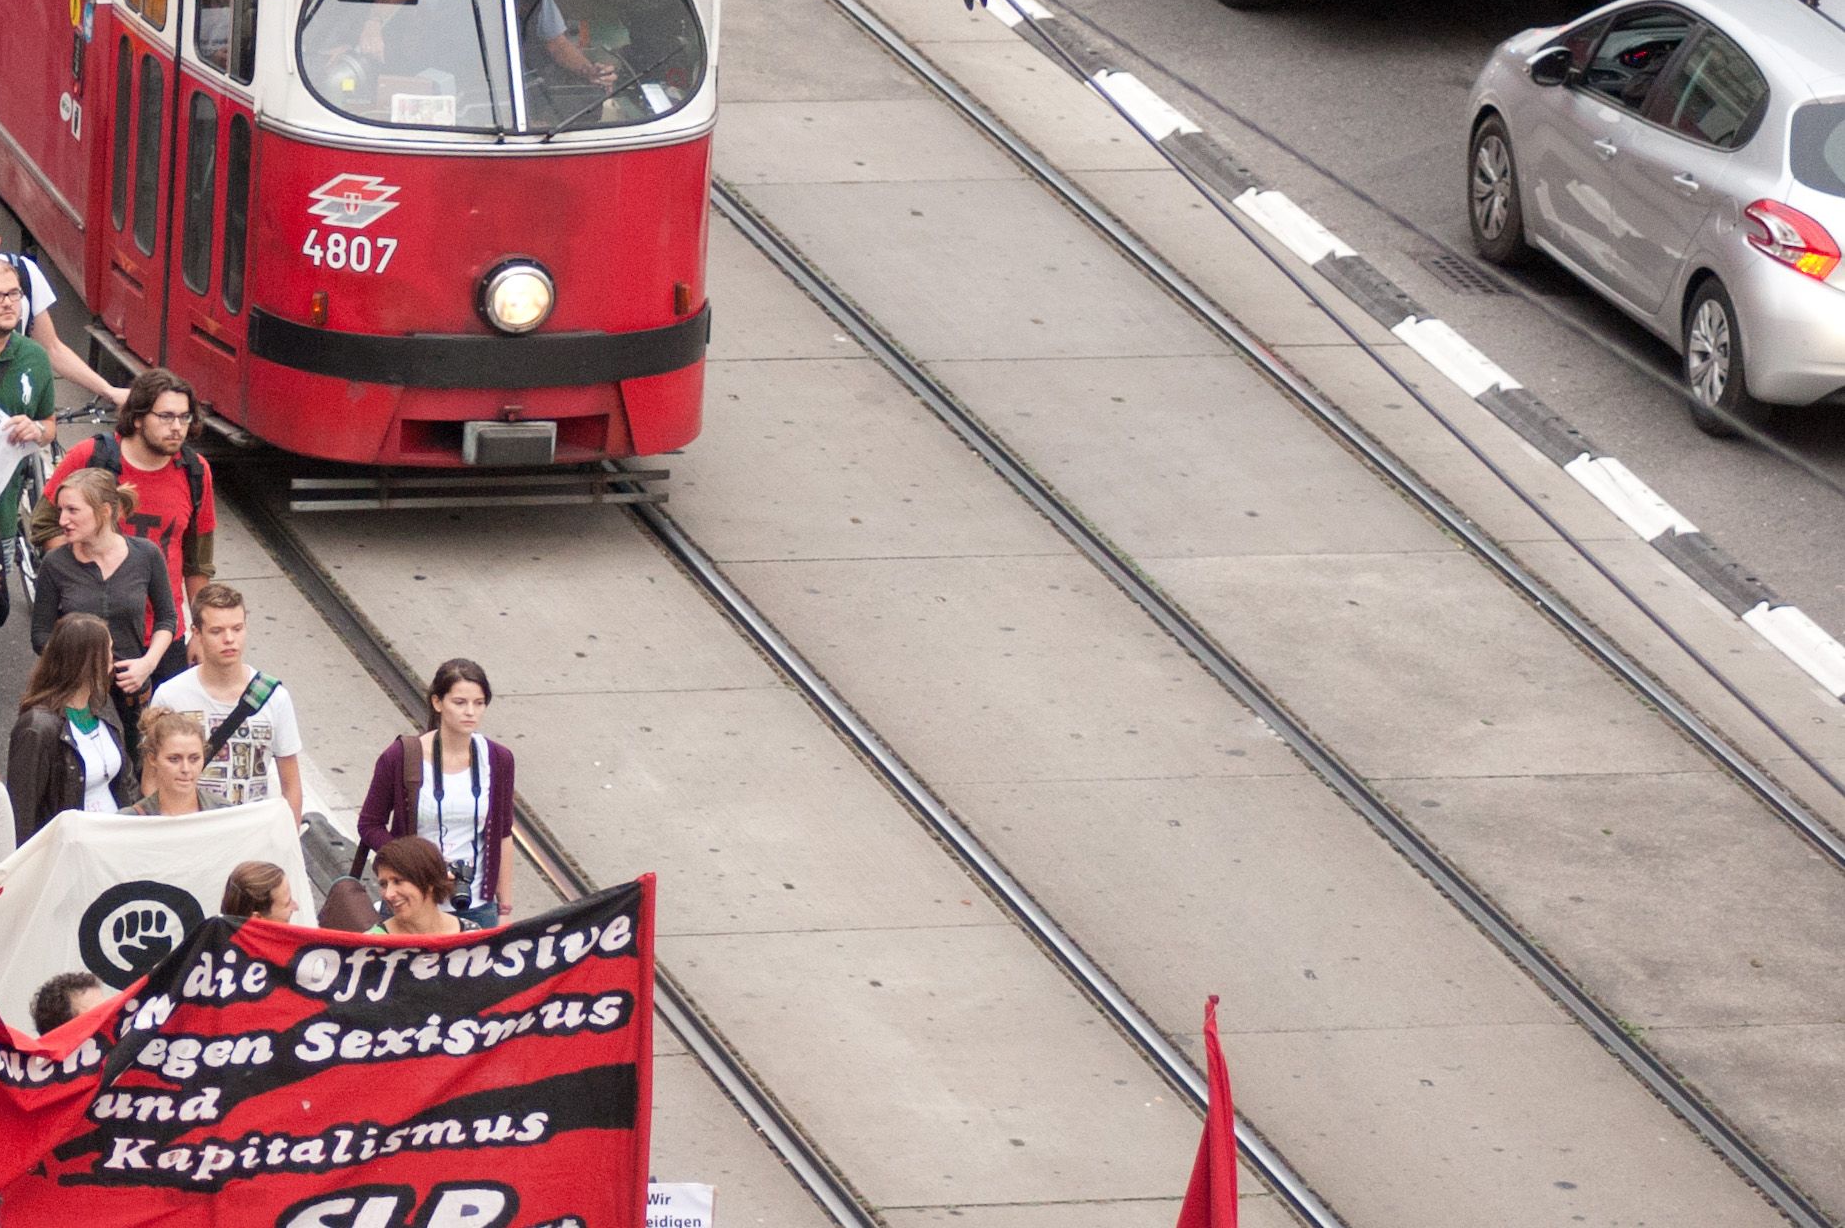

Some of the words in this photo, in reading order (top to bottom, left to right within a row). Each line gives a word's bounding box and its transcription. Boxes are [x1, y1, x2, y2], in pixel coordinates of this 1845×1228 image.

[302, 228, 398, 274] 4807
[183, 949, 268, 1000] die
[294, 913, 633, 1003] Offensive
[137, 1031, 274, 1079] egen
[294, 994, 625, 1064] Sexismus
[93, 1086, 221, 1121] und
[102, 1110, 552, 1183] Kapitalismus
[645, 1215, 702, 1228] eidigen
[646, 1193, 672, 1206] Wir
